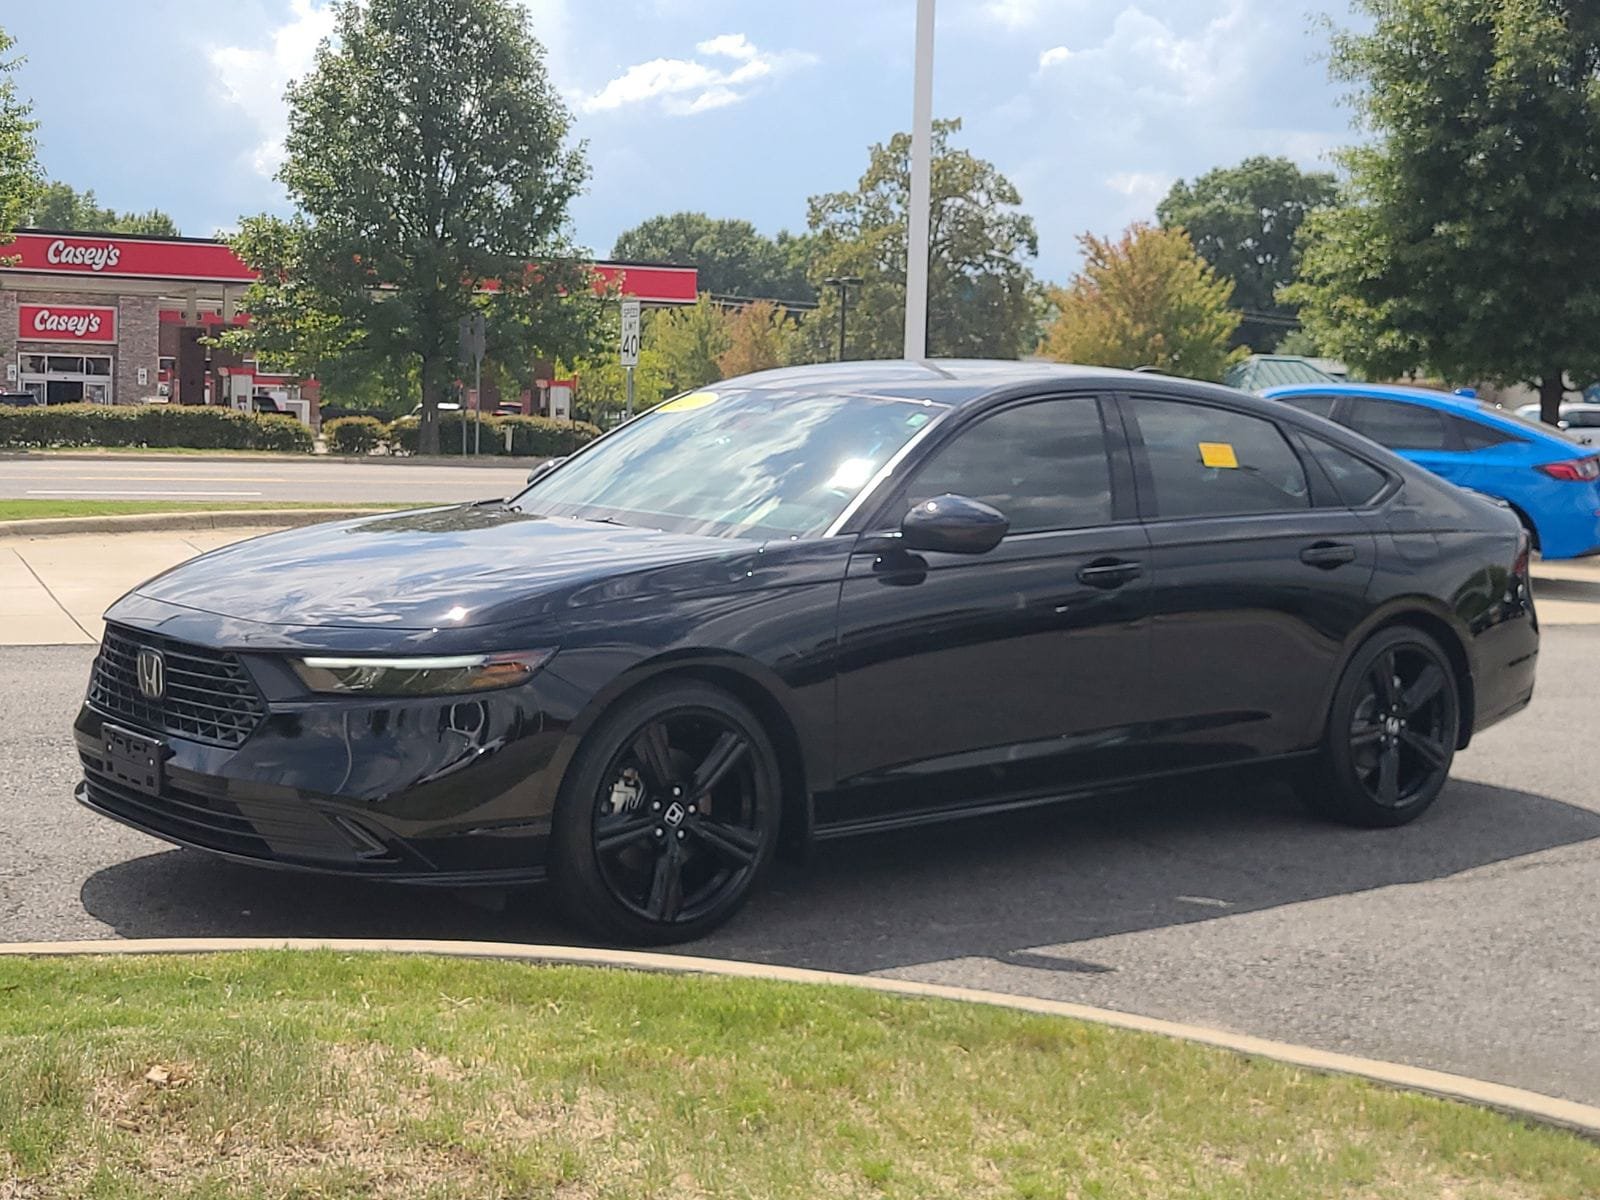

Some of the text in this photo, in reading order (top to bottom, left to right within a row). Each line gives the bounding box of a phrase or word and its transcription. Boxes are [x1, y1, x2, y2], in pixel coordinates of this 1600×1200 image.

[47, 240, 121, 271] Casey's
[34, 309, 101, 337] Casey's
[623, 334, 638, 358] 40
